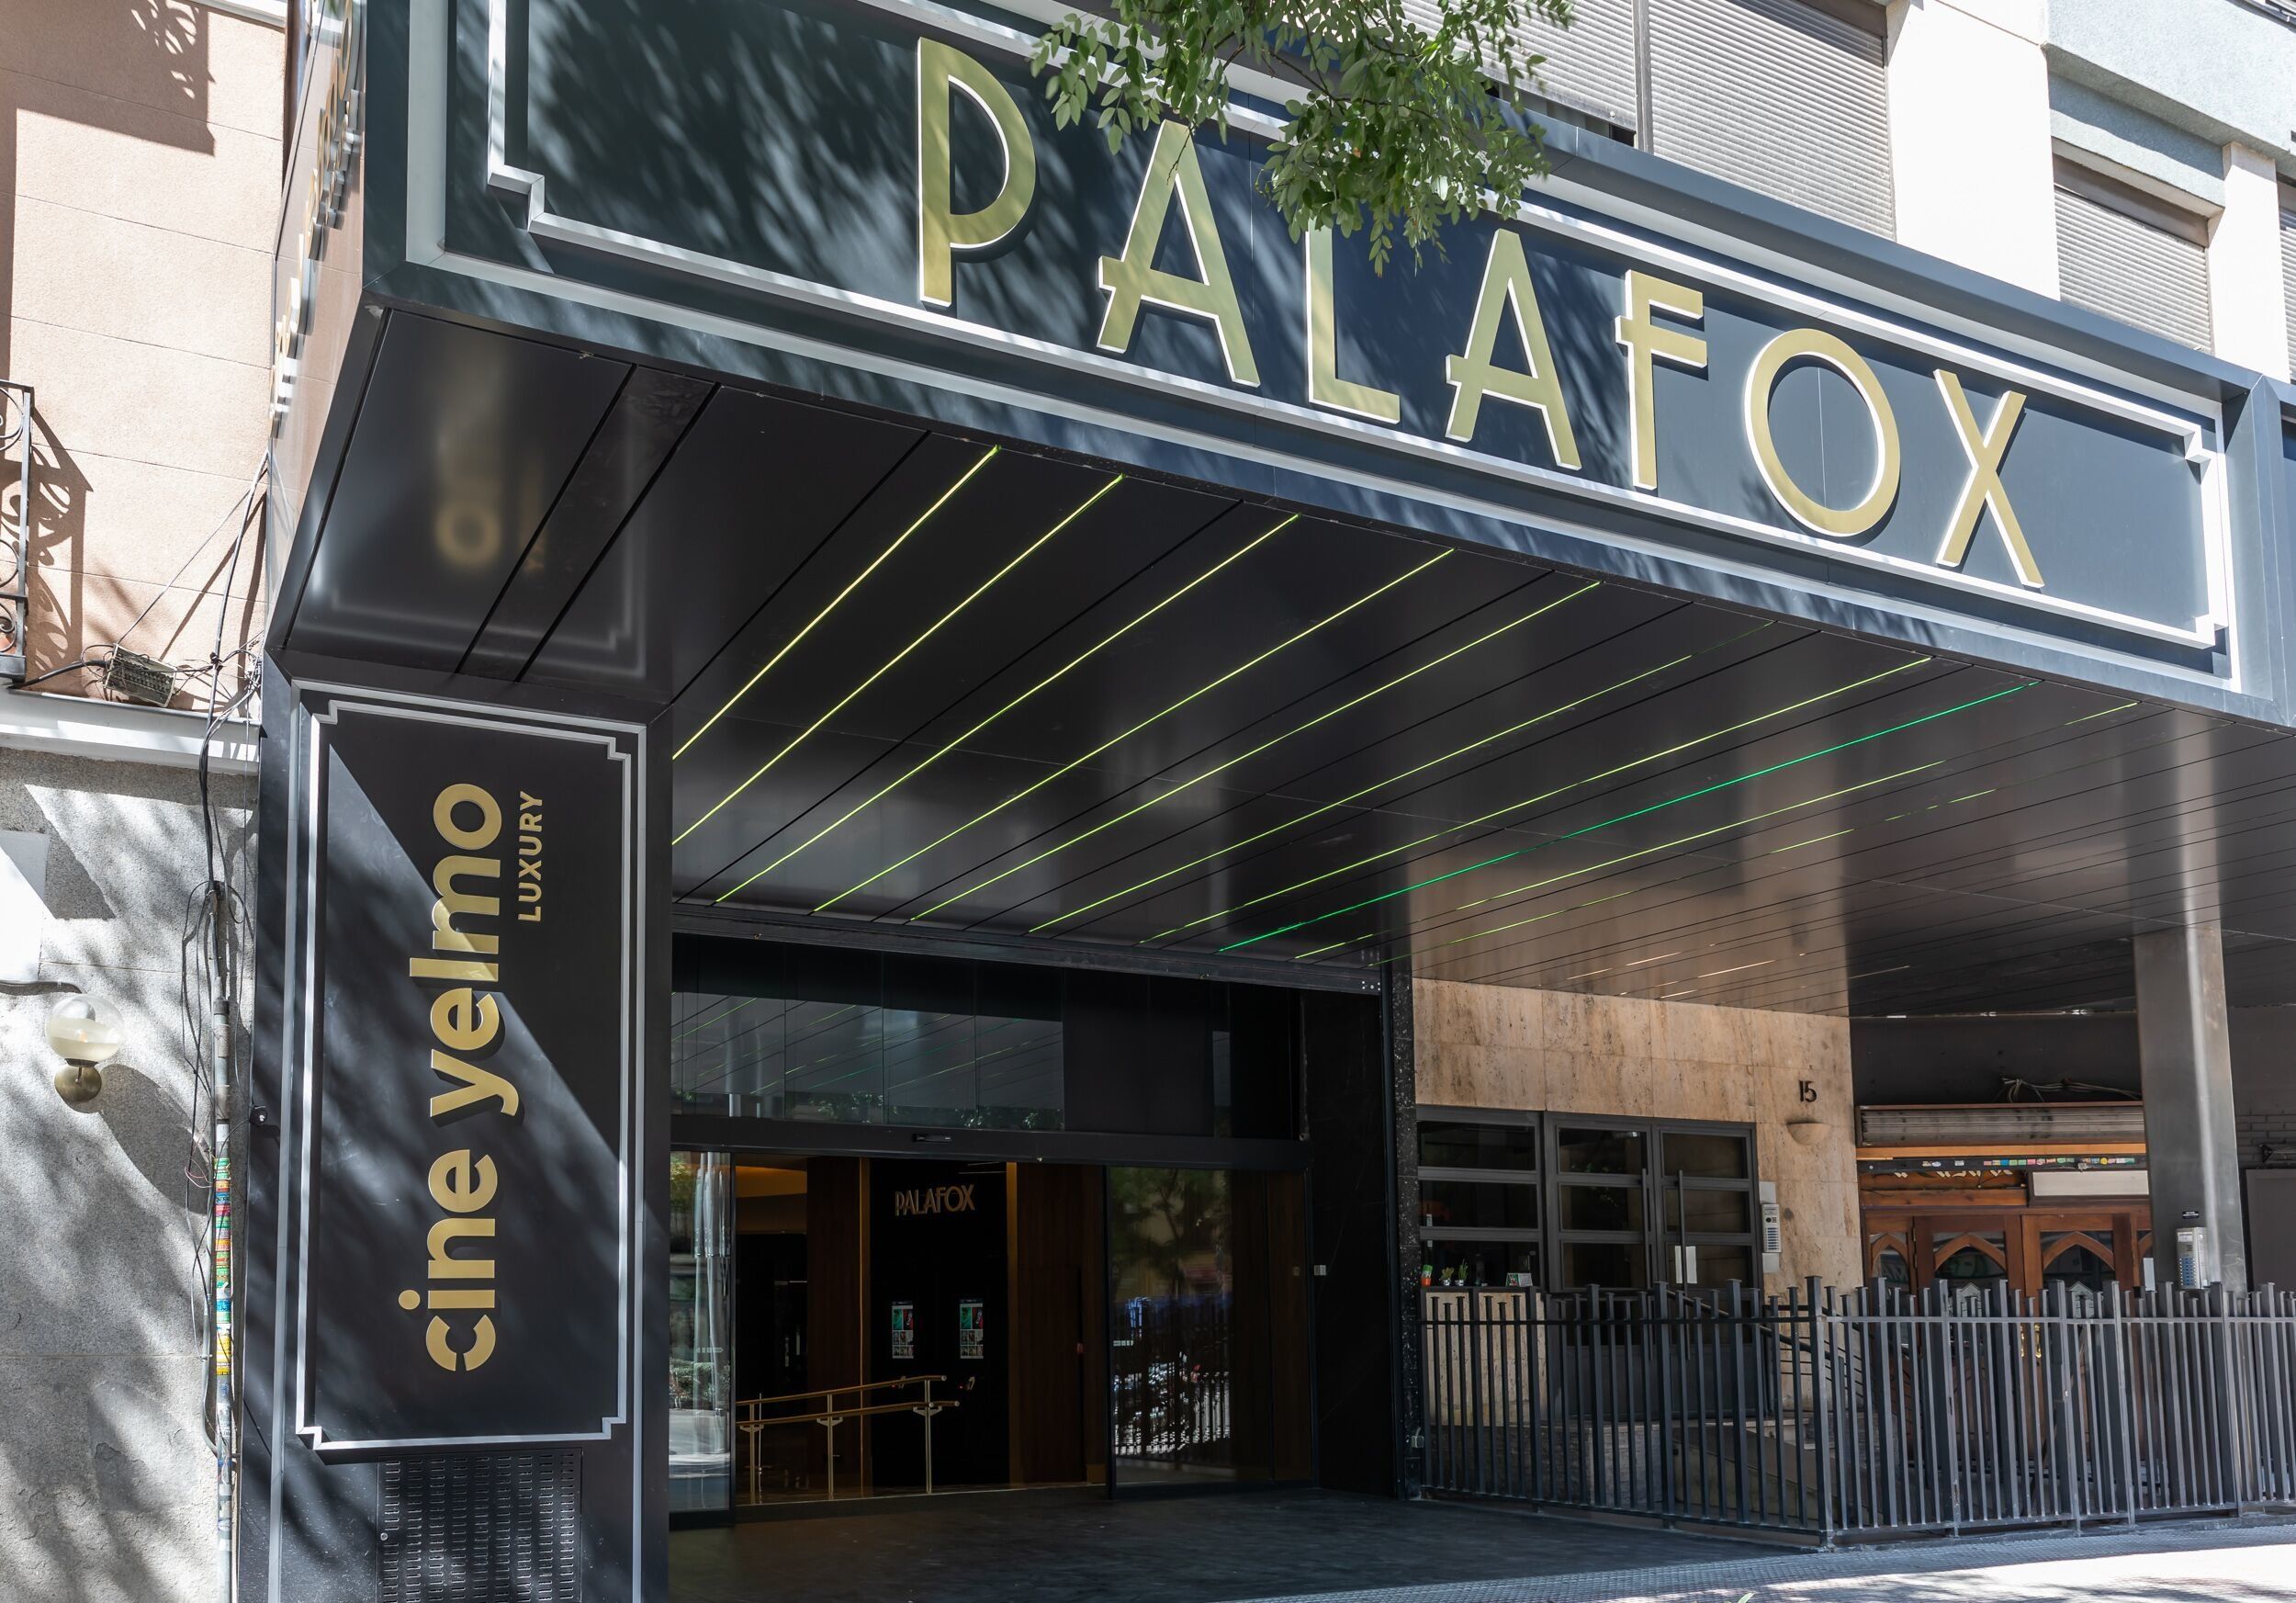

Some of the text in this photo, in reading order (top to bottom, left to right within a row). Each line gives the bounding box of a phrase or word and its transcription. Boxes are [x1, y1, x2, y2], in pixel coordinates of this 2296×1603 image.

[917, 37, 2044, 589] PALAFOX
[517, 791, 544, 923] LUXURY
[399, 783, 520, 1372] cine yelmo
[1798, 1079, 1818, 1103] 15
[895, 1183, 976, 1217] PALAFOX
